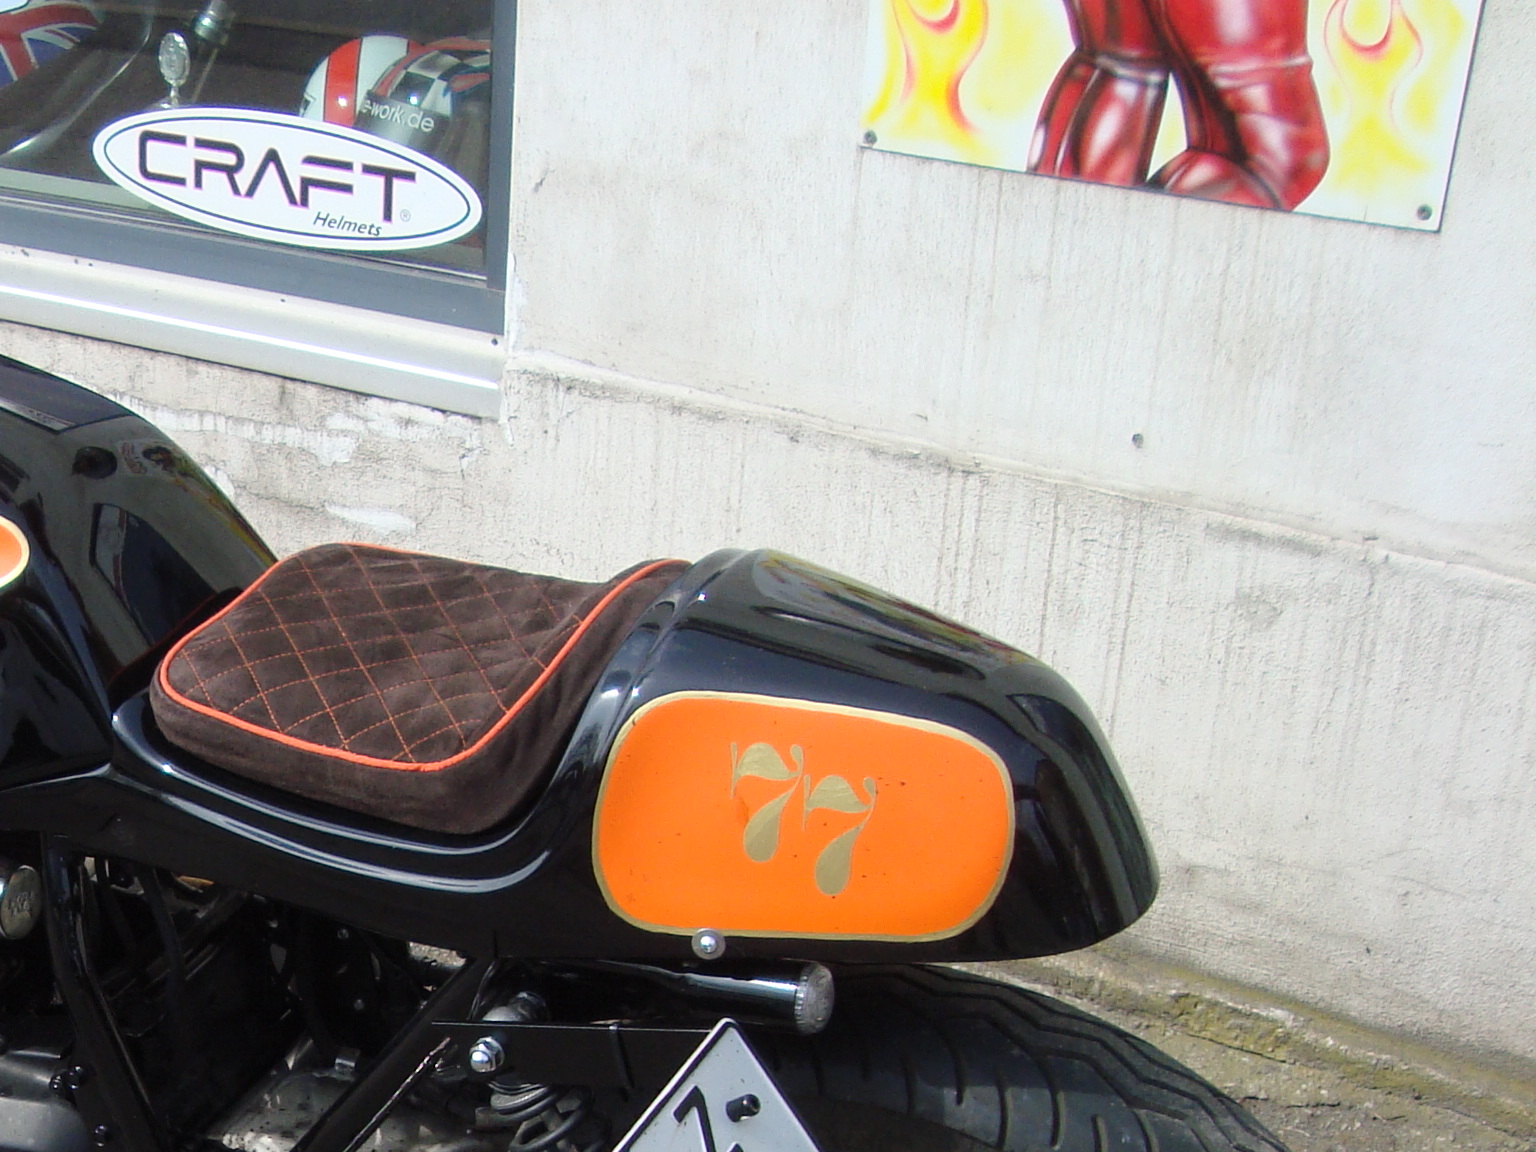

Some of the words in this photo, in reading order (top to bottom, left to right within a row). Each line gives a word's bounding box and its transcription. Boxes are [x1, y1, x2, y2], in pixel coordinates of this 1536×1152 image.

[138, 130, 416, 223] CRAFT
[312, 210, 383, 237] Helmets
[730, 741, 877, 896] 77
